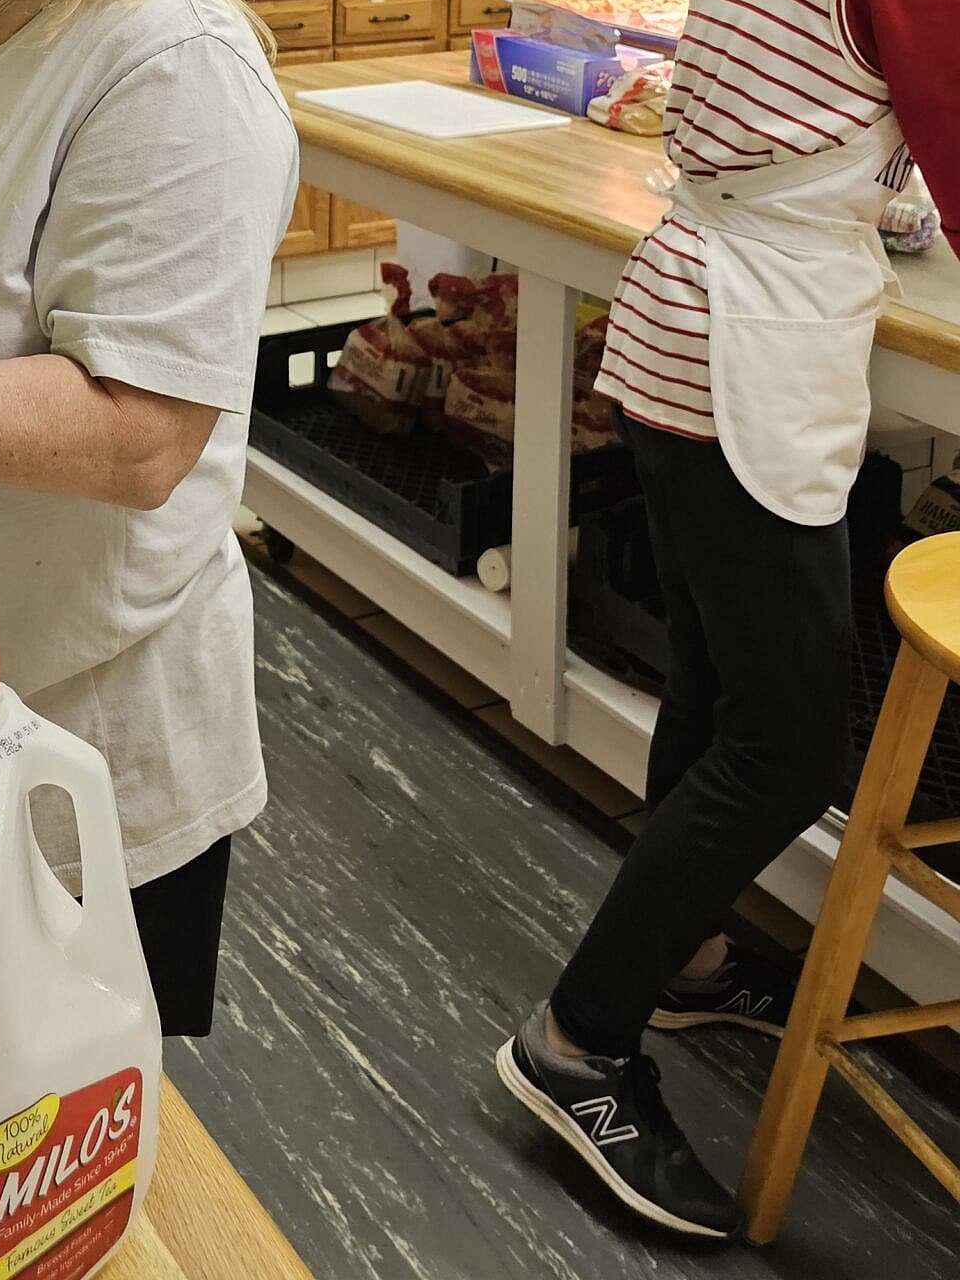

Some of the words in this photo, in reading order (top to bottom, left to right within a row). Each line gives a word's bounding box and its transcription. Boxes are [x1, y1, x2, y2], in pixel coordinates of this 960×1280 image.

[3, 1107, 43, 1142] 100%
[73, 1164, 102, 1193] Since
[6, 1225, 57, 1273] Famous
[60, 1191, 95, 1234] Sweet
